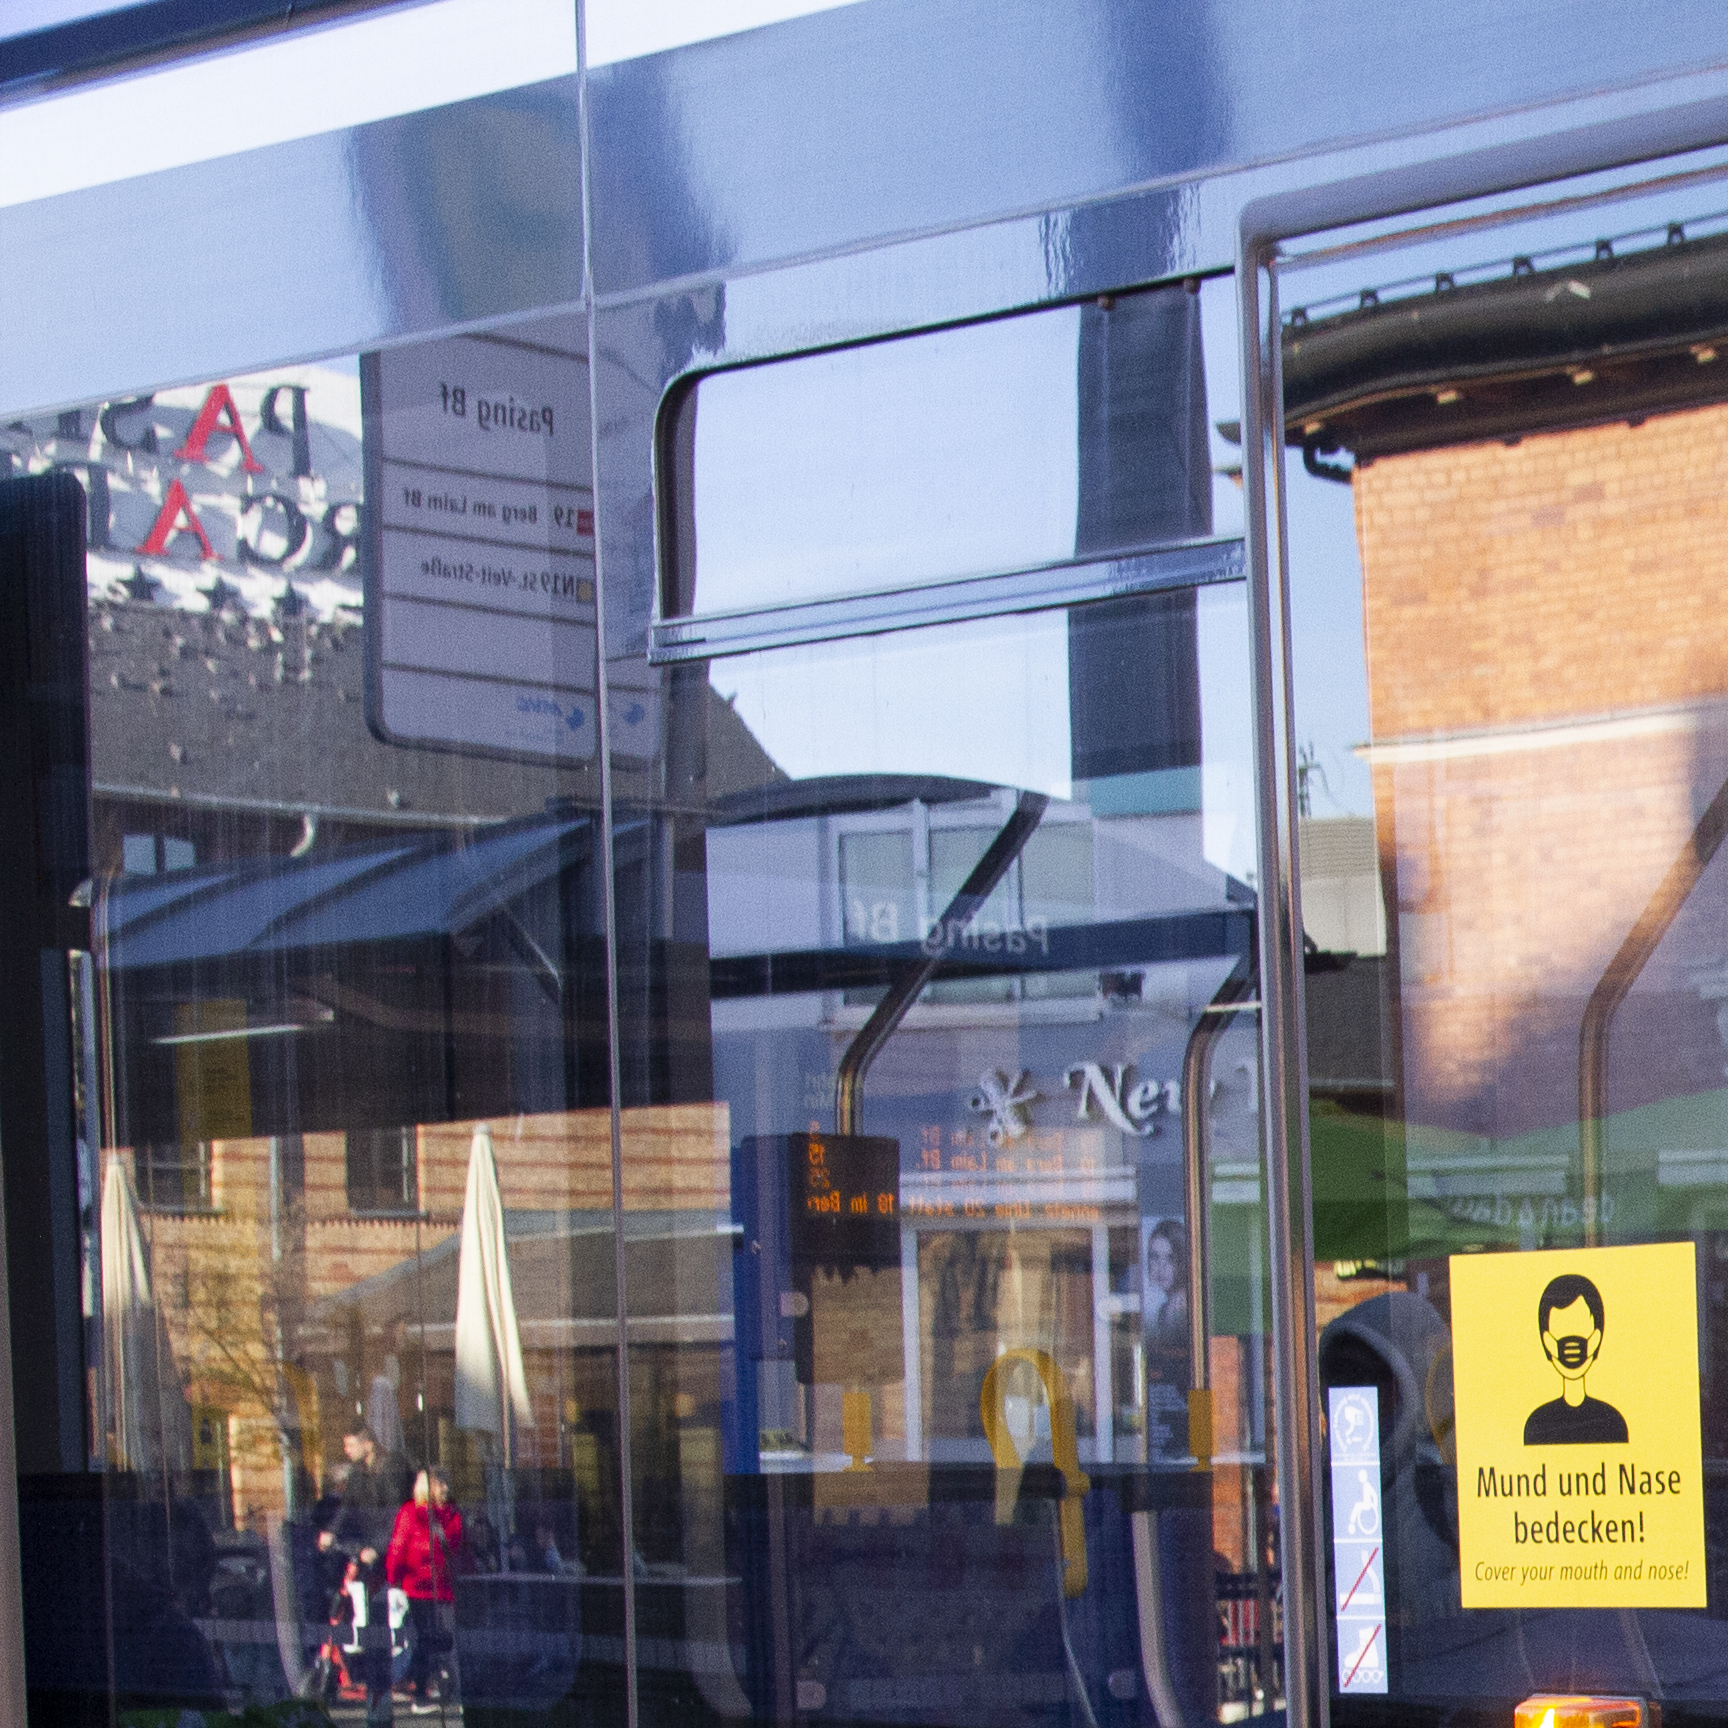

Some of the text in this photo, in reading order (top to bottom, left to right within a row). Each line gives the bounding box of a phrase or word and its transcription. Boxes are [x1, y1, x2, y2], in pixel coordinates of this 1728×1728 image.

[1476, 1462, 1682, 1499] Mund und Nase
[1513, 1510, 1646, 1545] bedecken!
[1474, 1559, 1691, 1587] Cover your mouth and nose!
